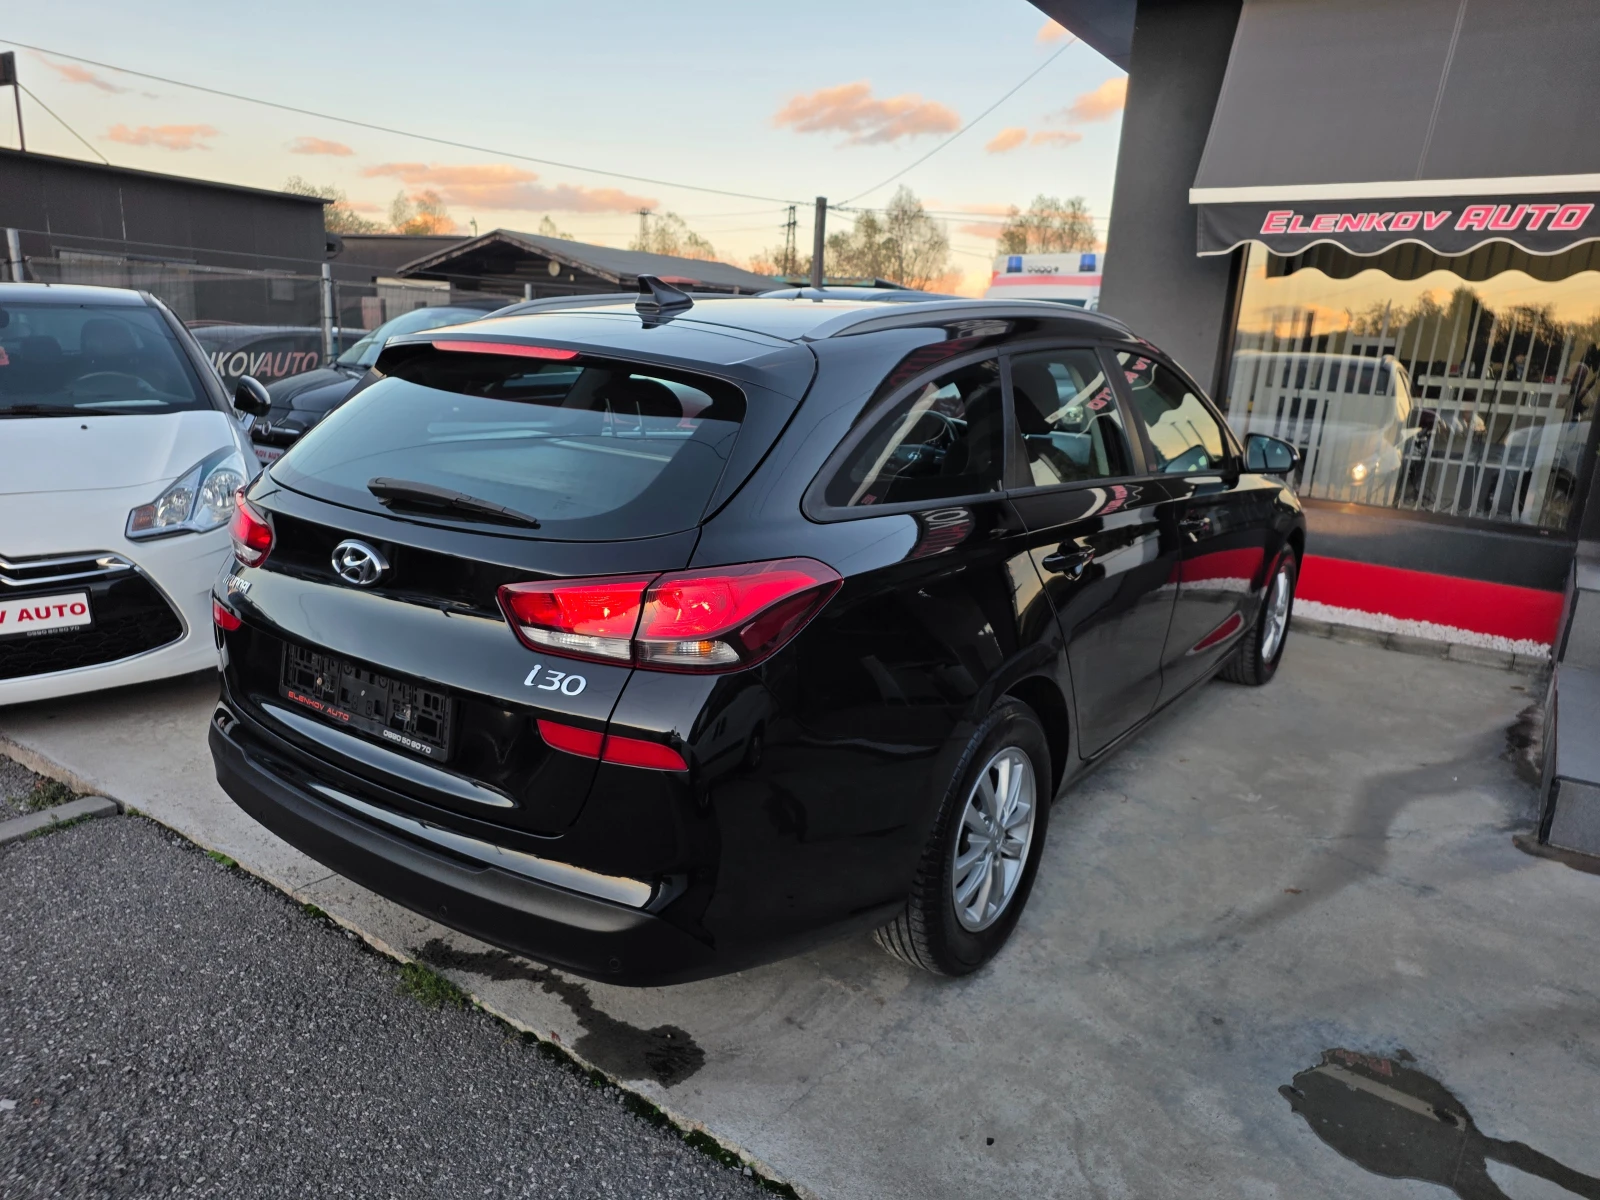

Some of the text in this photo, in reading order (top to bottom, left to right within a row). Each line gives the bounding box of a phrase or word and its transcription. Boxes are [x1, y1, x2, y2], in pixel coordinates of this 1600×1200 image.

[1260, 203, 1595, 234] ELENKOV AUTO
[17, 602, 87, 622] AUTO
[523, 664, 587, 696] i30
[326, 707, 350, 721] AUTO
[421, 744, 432, 754] 70
